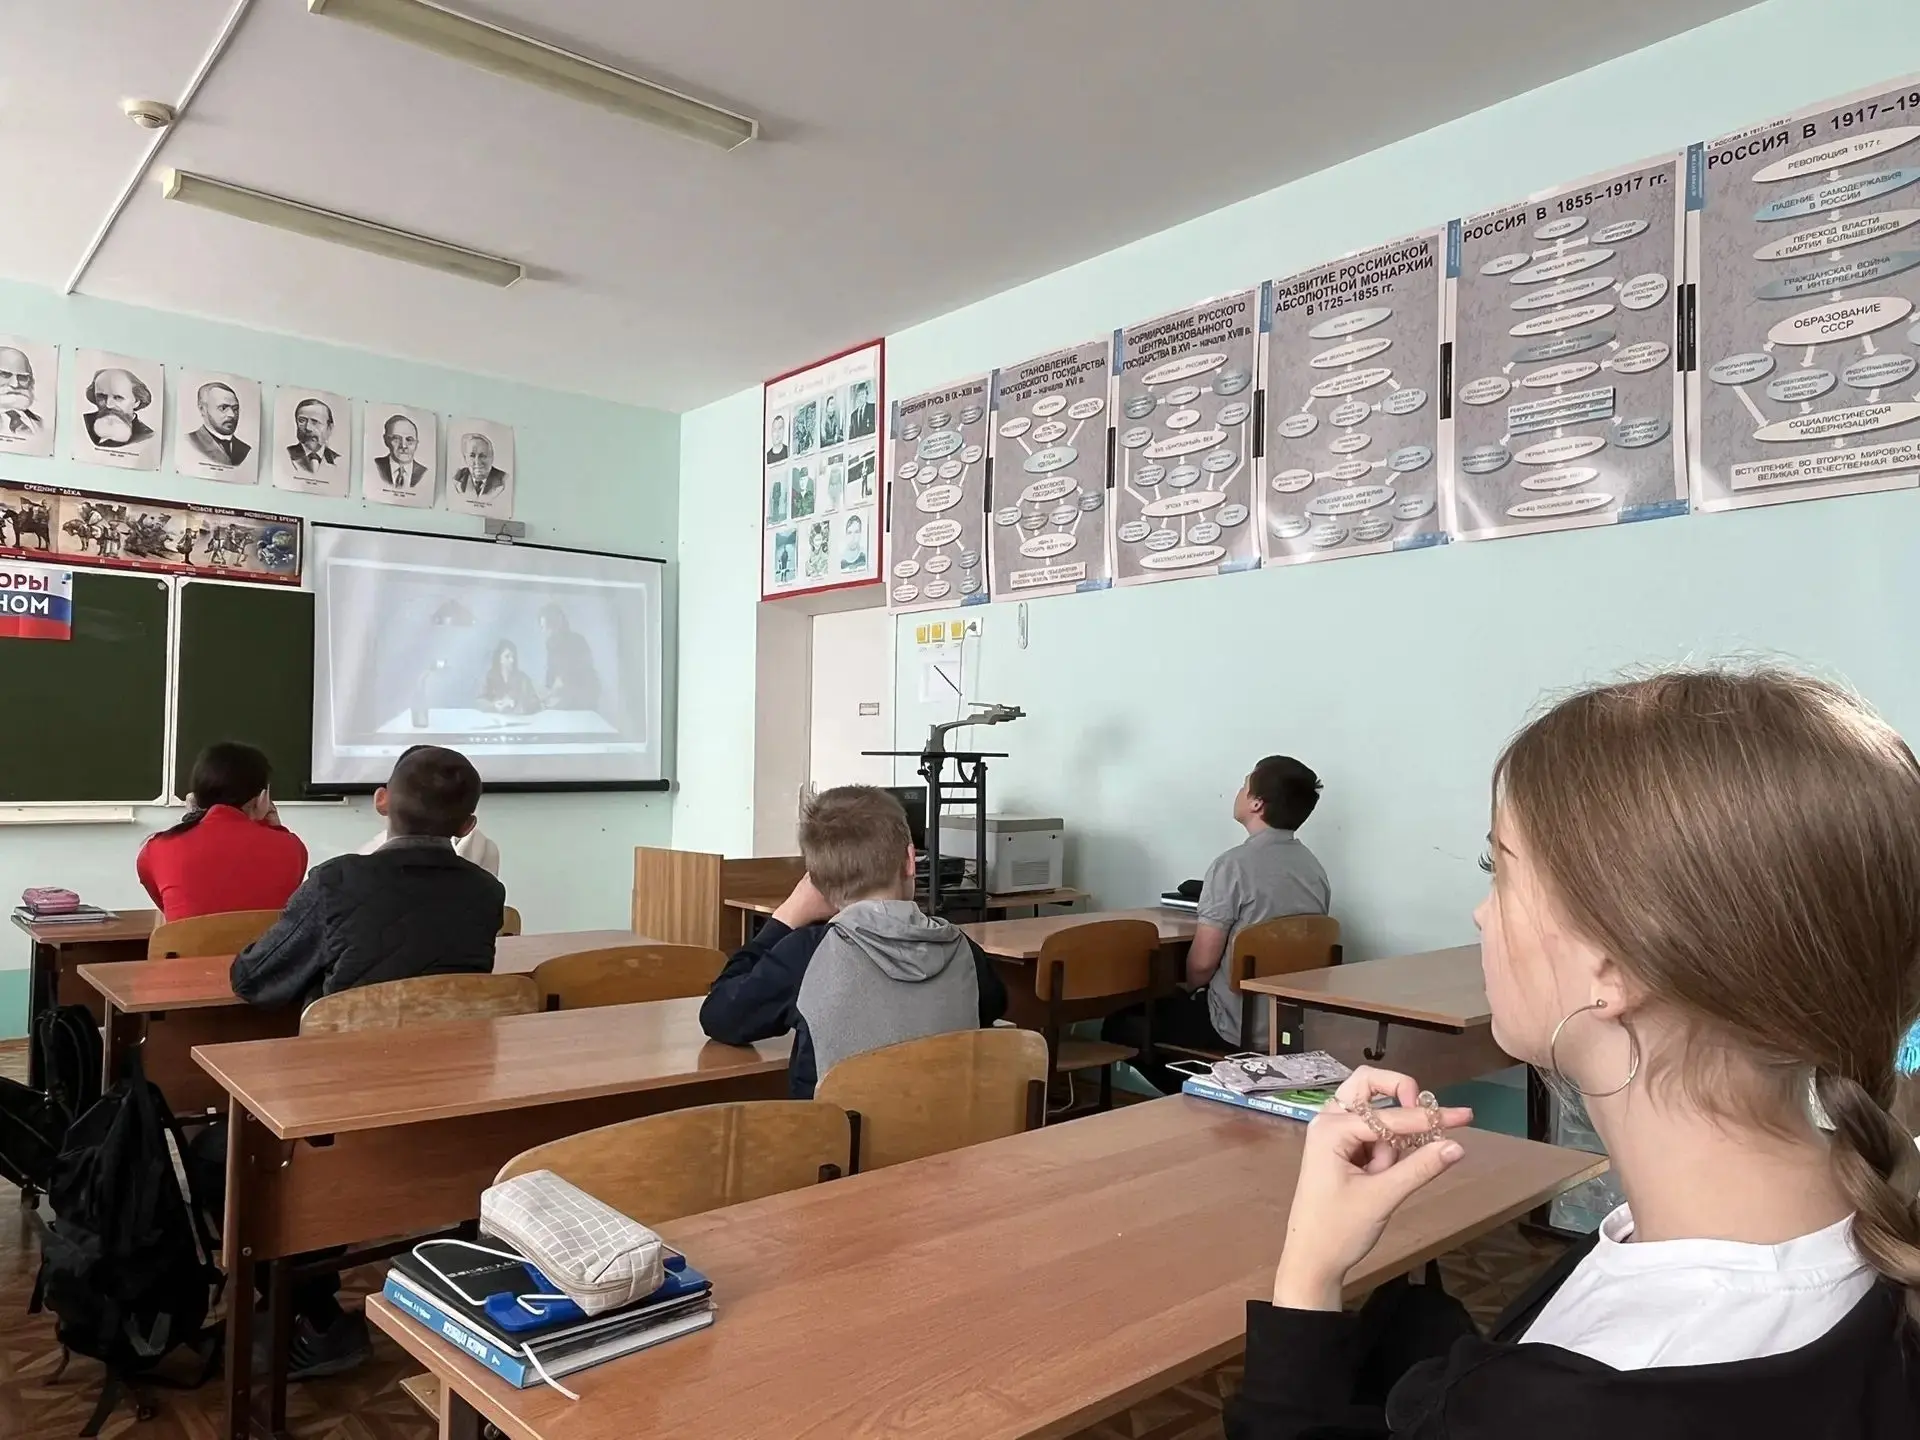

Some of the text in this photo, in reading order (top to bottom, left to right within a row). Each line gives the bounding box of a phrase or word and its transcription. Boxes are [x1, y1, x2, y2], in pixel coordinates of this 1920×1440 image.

[1708, 131, 1789, 170] РОССИЯ
[1803, 123, 1816, 139] В
[1788, 147, 1848, 169] РЕВОЛЮЦИЯ
[1853, 140, 1875, 152] 1917
[1772, 172, 1902, 211] ПАДЕНИЕ САМОДЕРЖАВИЯ
[1820, 191, 1861, 207] РОССИИ
[1463, 213, 1527, 243] РОССИЯ
[1536, 207, 1547, 220] В
[1557, 177, 1643, 214] 1855–1917
[1649, 173, 1668, 187] гг.
[1785, 239, 1822, 254] ПАРТИИ
[1827, 220, 1900, 244] БОЛЬШЕВИКОВ
[1793, 216, 1880, 243] ПЕРЕХОД ВЛАСТИ
[1275, 277, 1357, 314] АБСОЛЮТНОЙ
[1360, 255, 1433, 287] МОНАРХИИ
[1279, 272, 1336, 300] РАЗВИТИЕ
[1340, 241, 1429, 279] РОССИЙСКОЙ
[1783, 256, 1890, 286] ГРАЖДАНСКАЯ ВОЙНА
[1807, 268, 1878, 290] ИНТЕРВЕНЦИЯ
[1306, 282, 1394, 316] В 1725–1855 гг.
[1128, 317, 1194, 346] ФОРМИРОВАНИЕ
[1198, 302, 1246, 324] РУССКОГО
[1794, 303, 1881, 328] ОБРАЗОВАНИЕ
[1820, 320, 1854, 334] СССР
[1138, 318, 1233, 355] ЦЕНТРАЛИЗОВАННОГО
[1020, 354, 1078, 380] СТАНОВЛЕНИЕ
[1122, 346, 1170, 370] ГОСУДАРСТВА
[1171, 345, 1177, 355] В
[1000, 357, 1105, 396] МОСКОВСКОГО ГОСУДАРСТВА
[1789, 406, 1892, 429] СОЦИАЛИСТИЧЕСКАЯ
[1800, 417, 1879, 436] МОДЕРНИЗАЦИЯ
[1735, 462, 1793, 476] ВСТУПЛЕНИЕ
[1799, 458, 1811, 467] ВО
[1816, 452, 1856, 465] ВТОРУЮ
[1861, 445, 1911, 459] МИРОВУЮ
[1757, 468, 1799, 481] ВЕЛИКАЯ
[1804, 457, 1887, 475] ОТЕЧЕСТВЕННАЯ
[0, 572, 48, 591] ОРЫ
